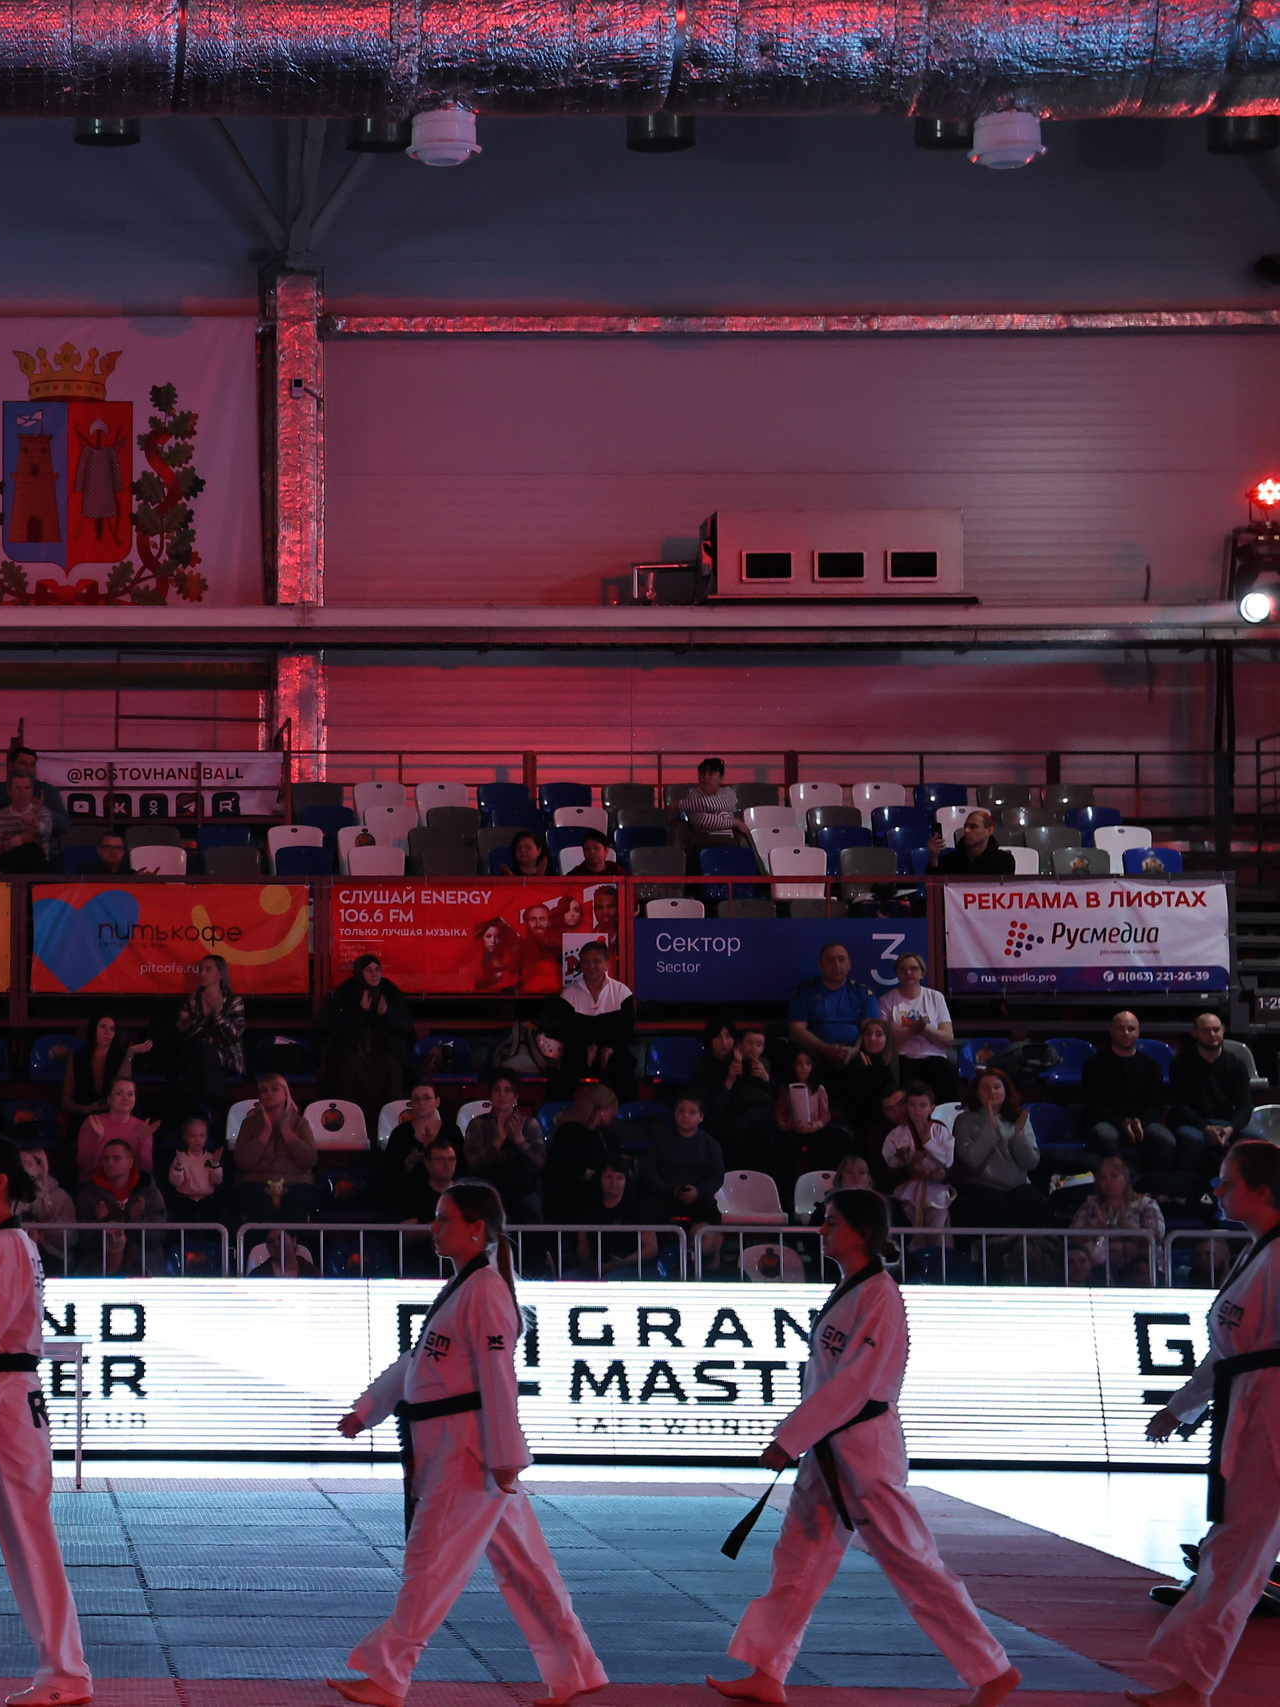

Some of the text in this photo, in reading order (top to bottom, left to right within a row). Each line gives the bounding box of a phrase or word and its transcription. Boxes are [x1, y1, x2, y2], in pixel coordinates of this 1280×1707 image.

[67, 767, 244, 783] @ROSTOVHANDBALL
[339, 886, 492, 904] СЛУШАЙ ENERGY
[963, 891, 1207, 910] РЕКЛАМА В ЛИФТАХ
[339, 909, 414, 923] 106.6 FM
[339, 928, 467, 937] ТОЛЬКО ЛУЧШАЯ МУЗЫКА
[1051, 922, 1159, 950] Русмедиа
[656, 932, 741, 957] Сектор
[656, 961, 701, 973] Sector
[870, 933, 906, 986] 3
[140, 963, 200, 975] pitcofe.ru
[1156, 972, 1210, 981] 221-26-39
[980, 973, 1057, 983] rus-media.pro
